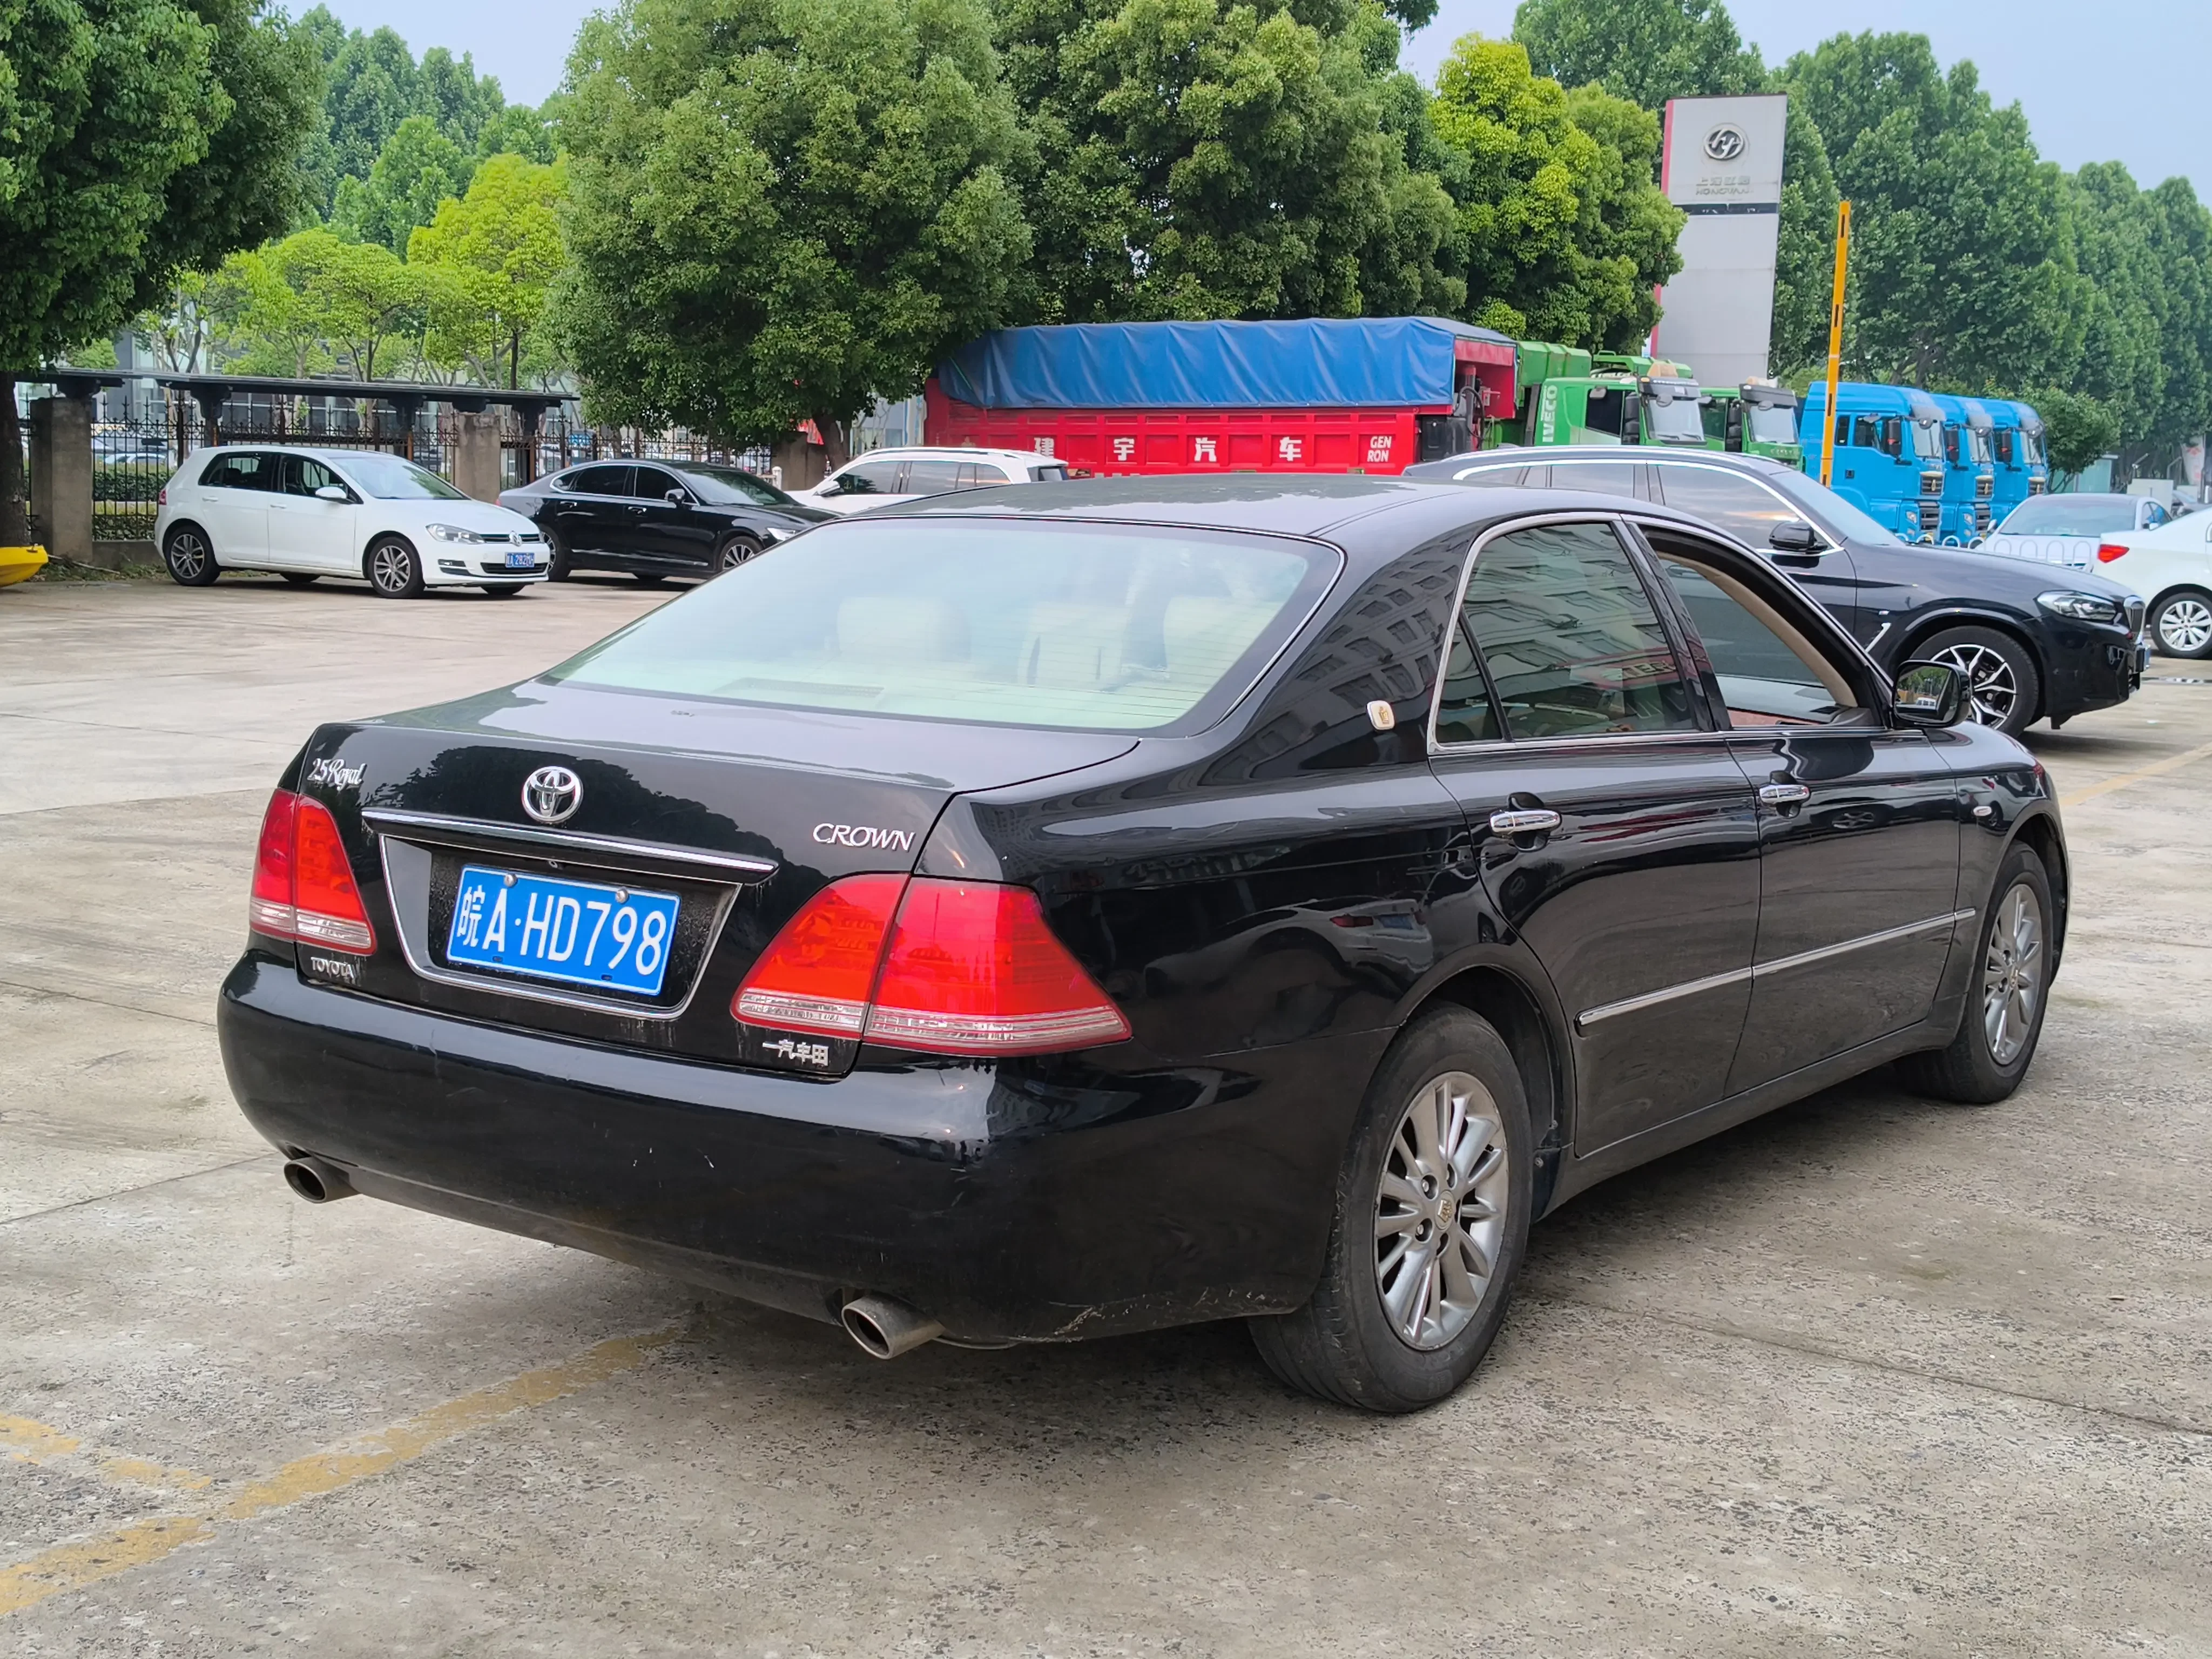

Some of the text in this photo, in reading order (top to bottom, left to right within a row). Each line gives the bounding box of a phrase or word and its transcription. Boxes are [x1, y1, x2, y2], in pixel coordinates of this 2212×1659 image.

[1542, 385, 1557, 442] IVECO
[1370, 436, 1392, 449] GEN
[1367, 450, 1390, 462] RON
[813, 823, 916, 852] CROWN
[311, 956, 354, 979] TOYOTA
[762, 1038, 829, 1067] 一汽丰田
